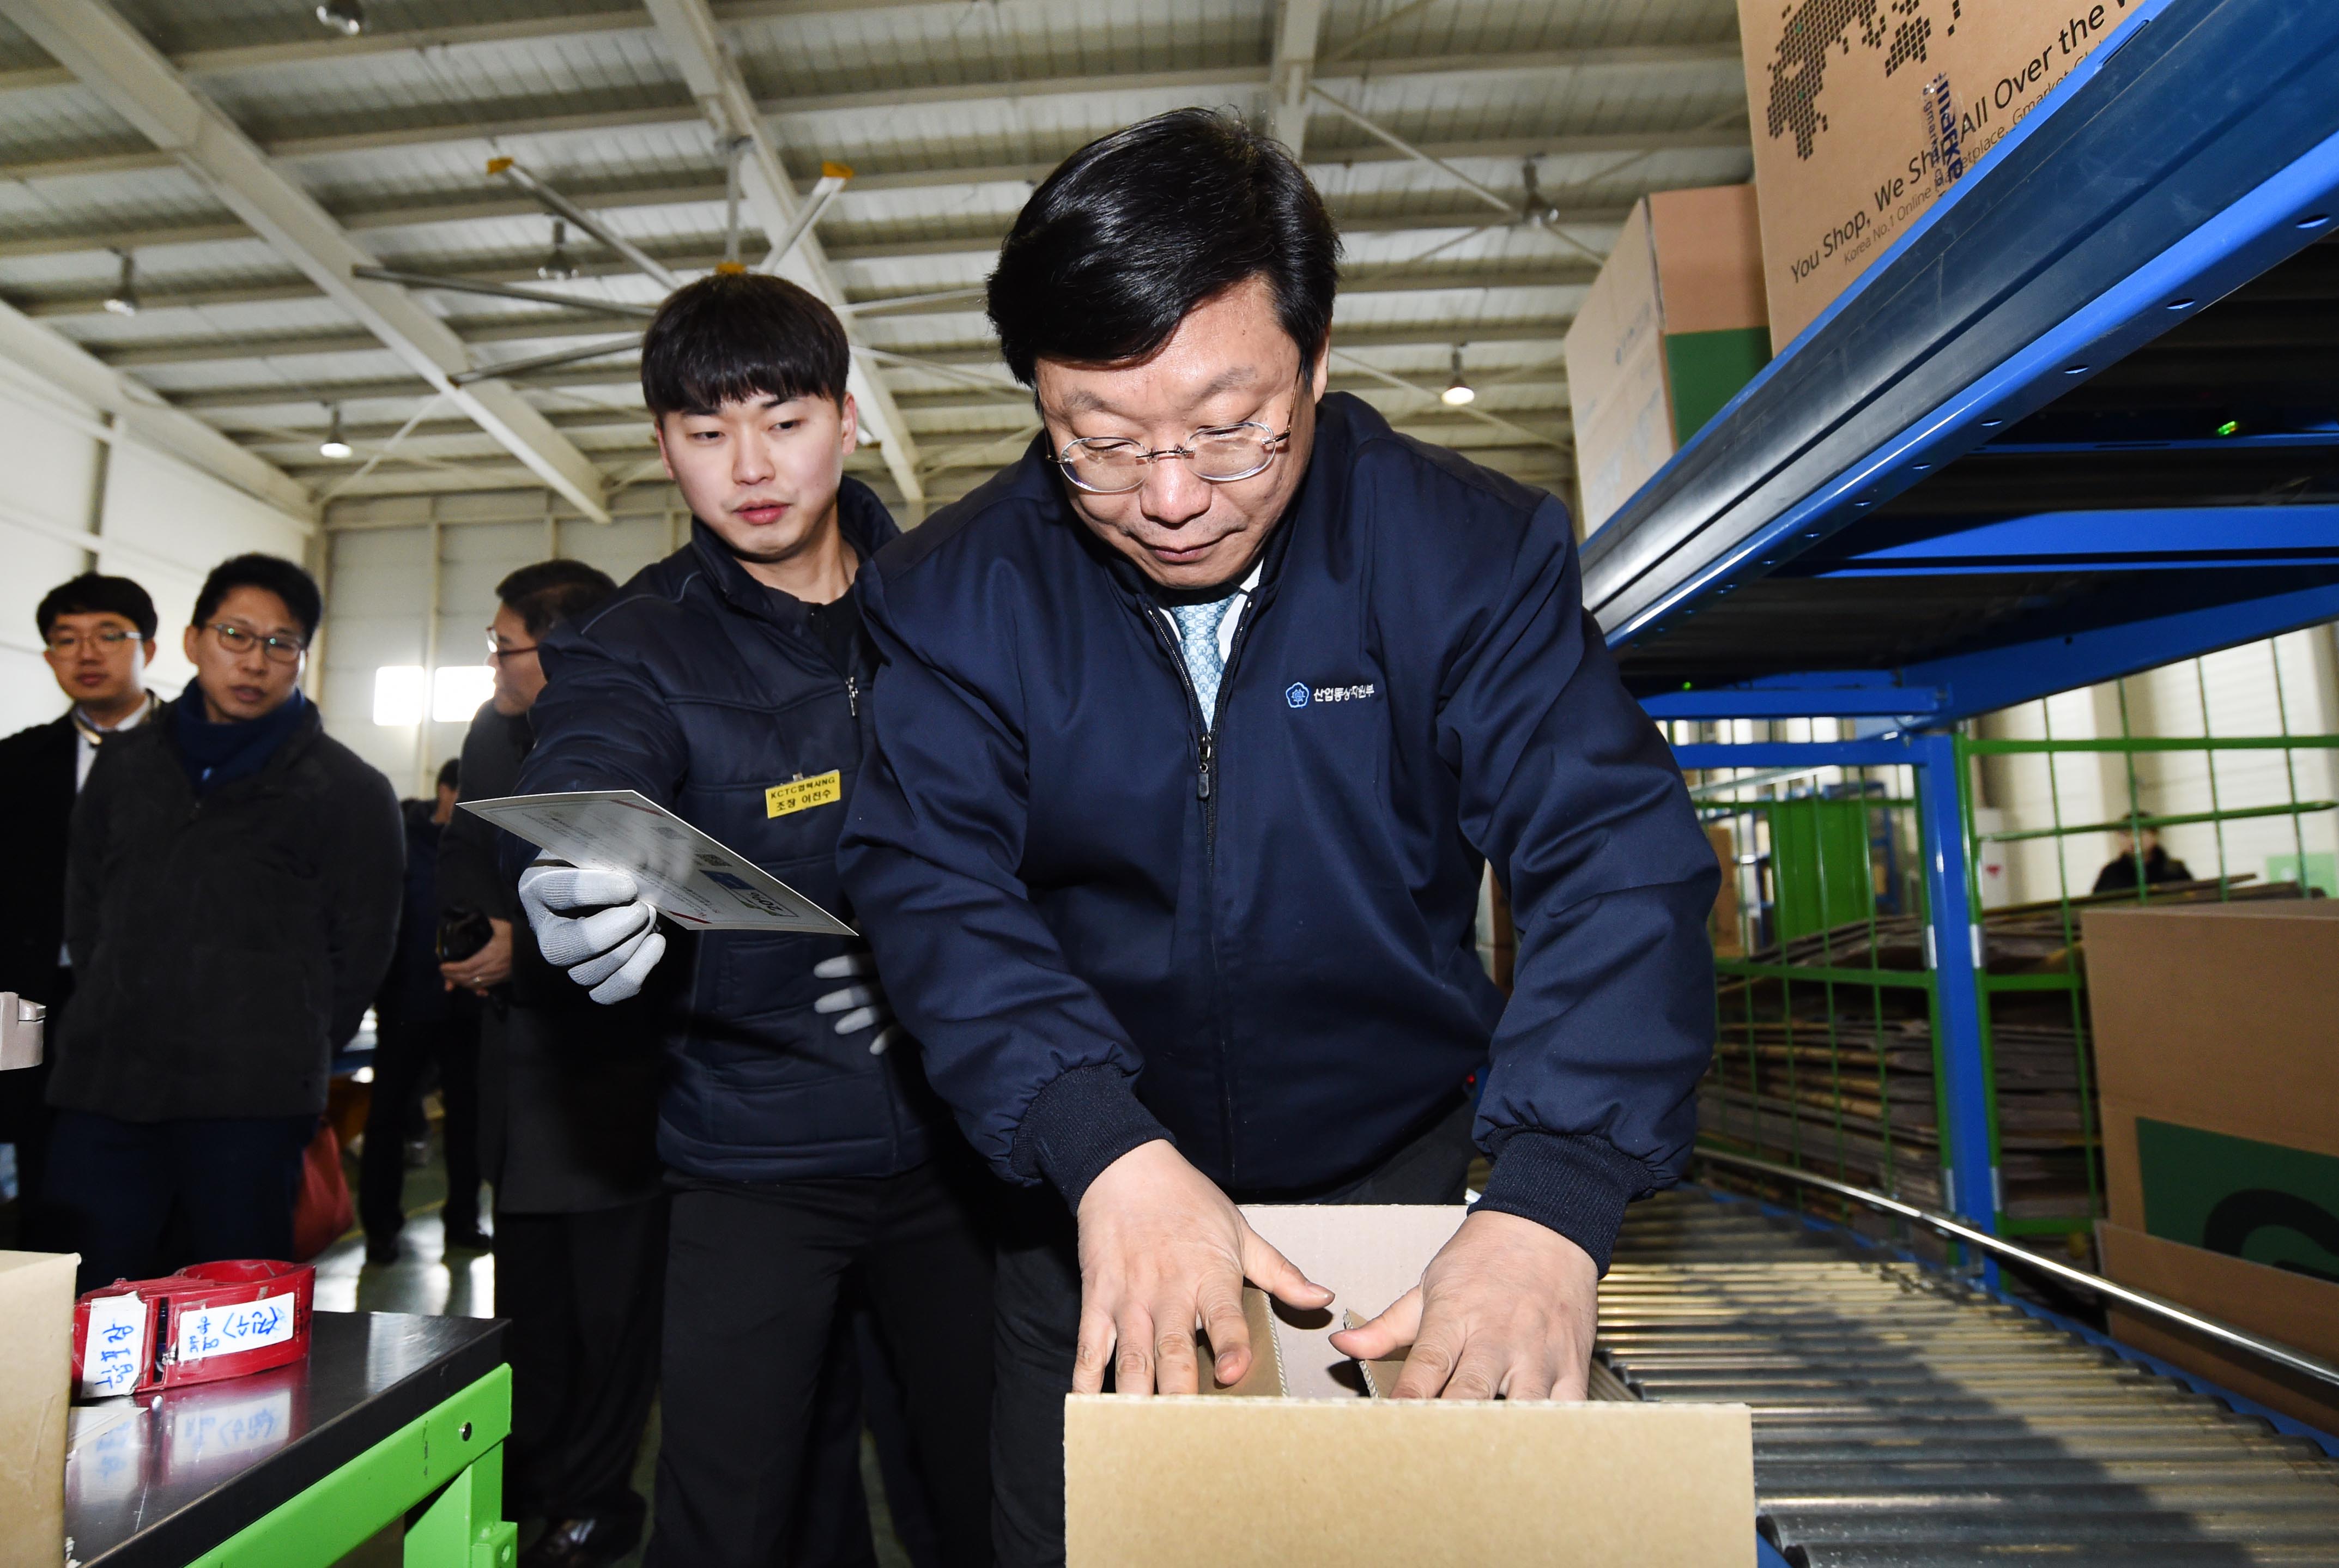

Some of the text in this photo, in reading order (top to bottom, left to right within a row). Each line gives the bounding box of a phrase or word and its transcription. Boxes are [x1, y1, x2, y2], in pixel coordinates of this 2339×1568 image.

[1791, 250, 1819, 283] You
[1823, 211, 1870, 257] Shop,
[1874, 178, 1904, 212] We
[1960, 96, 1988, 143] All
[1995, 45, 2052, 109] Over
[2058, 4, 2105, 55] the
[1844, 237, 1871, 265] Korea
[1873, 215, 1894, 241] No.1
[1896, 187, 1932, 221] Online
[1313, 683, 1374, 702] 산업통상자원부
[776, 798, 796, 812] 조장
